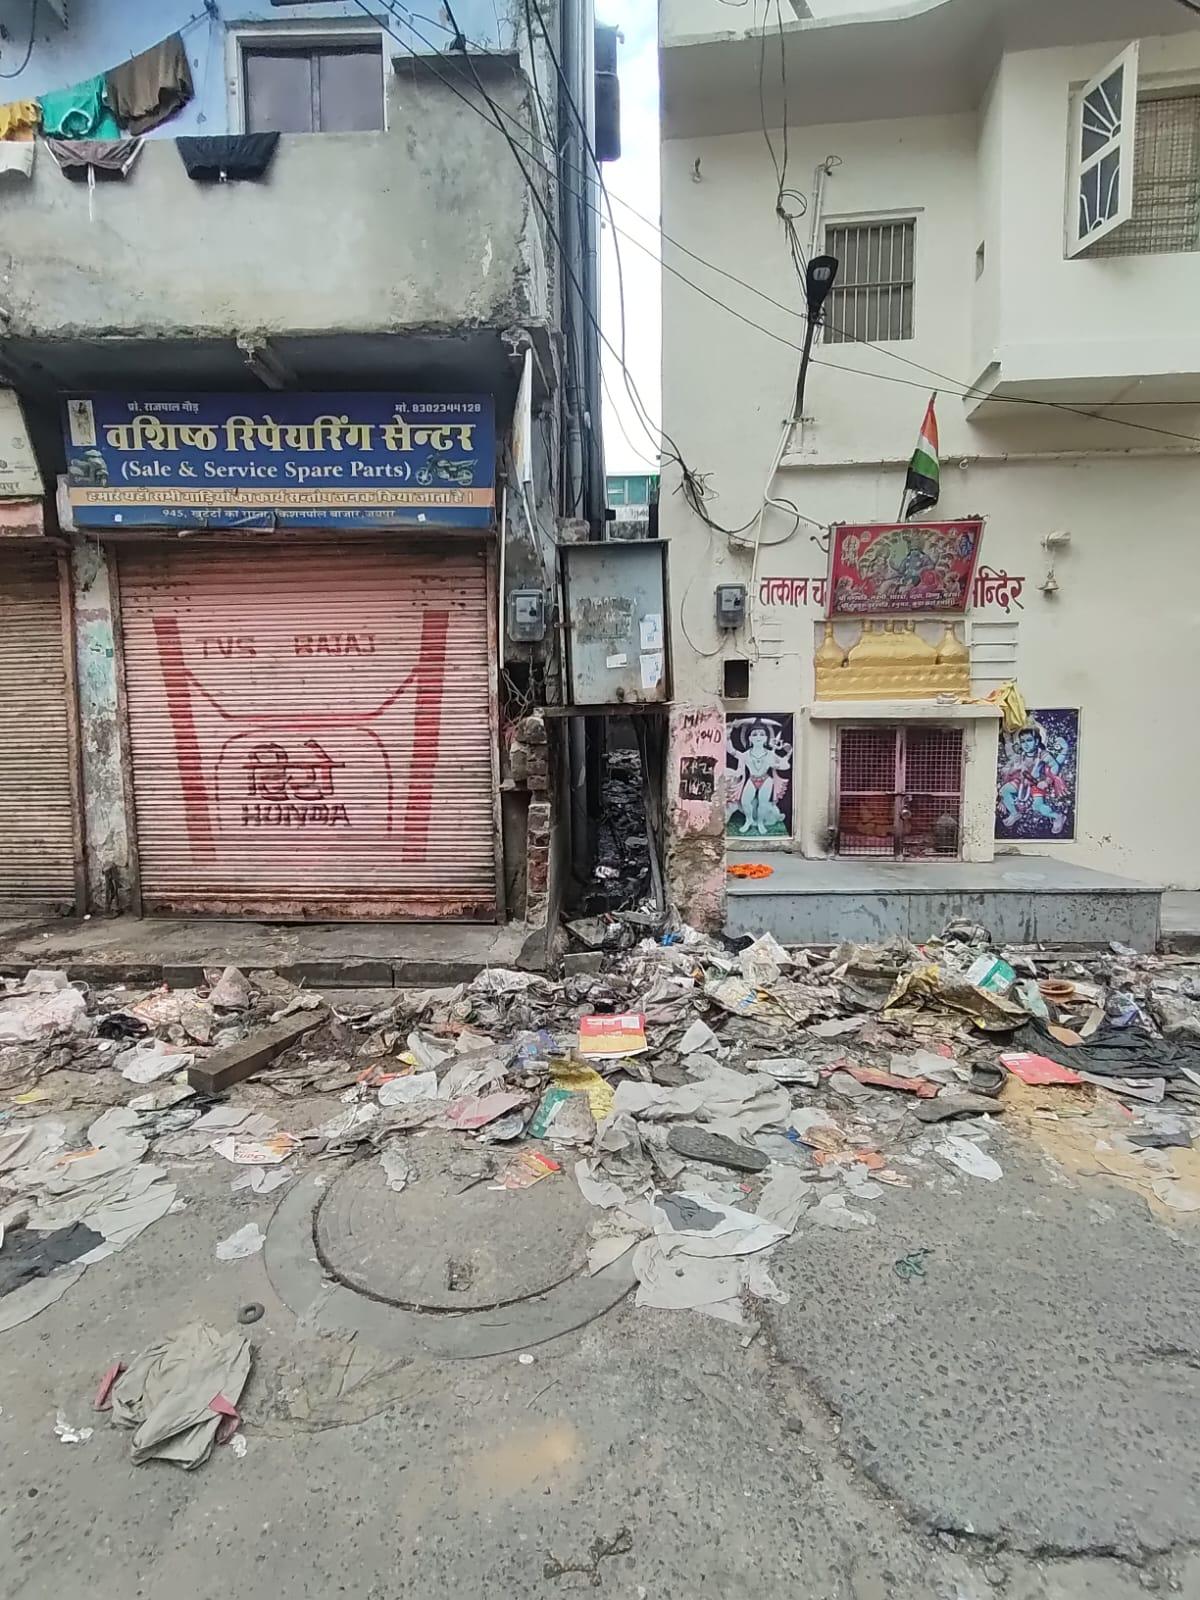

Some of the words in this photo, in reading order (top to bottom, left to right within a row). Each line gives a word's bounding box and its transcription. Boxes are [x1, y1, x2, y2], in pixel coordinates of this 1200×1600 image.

[394, 401, 410, 413] मो.
[412, 403, 481, 413] 8302344128
[103, 415, 219, 451] वशिष्ठ
[379, 414, 477, 451] सेन्टर
[121, 460, 172, 480] (Sale
[178, 461, 198, 478] &
[204, 461, 278, 478] Service
[284, 461, 343, 483] Spare
[350, 461, 412, 481] Parts)
[150, 488, 183, 502] सभी
[235, 490, 252, 503] का
[161, 509, 187, 519] 945,
[759, 577, 810, 608] तत्काल
[196, 636, 257, 658] TVS
[241, 803, 352, 827] HONDA
